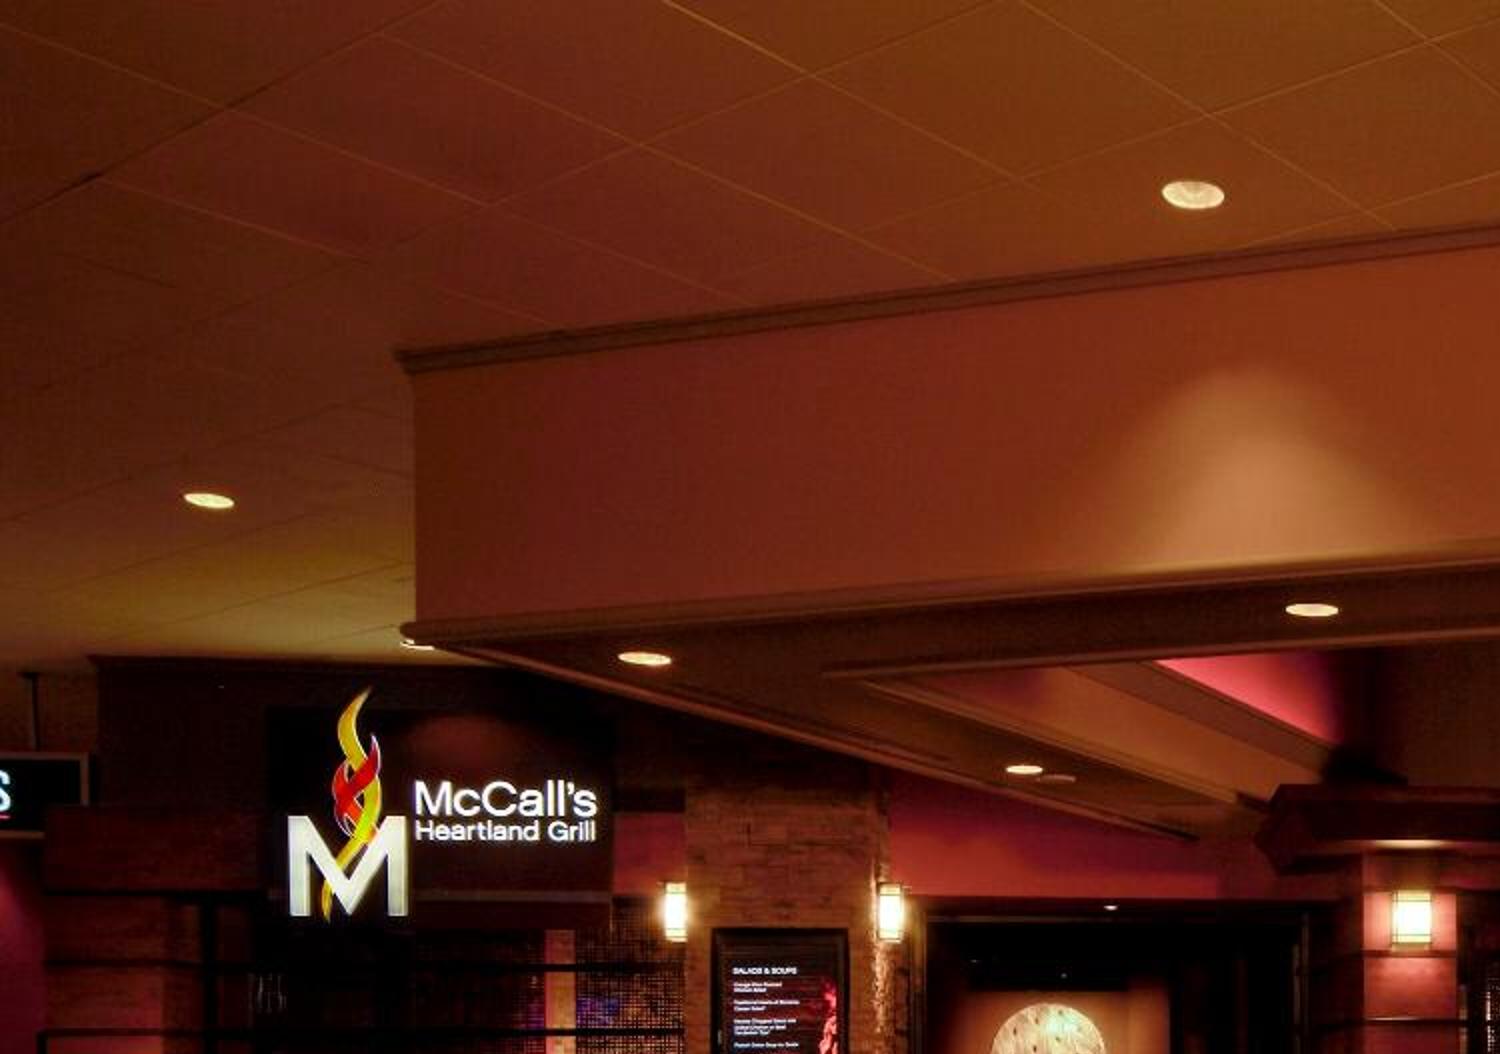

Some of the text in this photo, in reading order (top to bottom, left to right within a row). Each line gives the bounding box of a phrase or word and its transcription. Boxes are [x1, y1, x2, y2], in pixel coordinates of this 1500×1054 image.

[414, 779, 597, 817] McCall's
[415, 820, 597, 842] Heartland Grill
[288, 815, 409, 918] M
[764, 967, 770, 975] &
[771, 967, 797, 975] SOUPS
